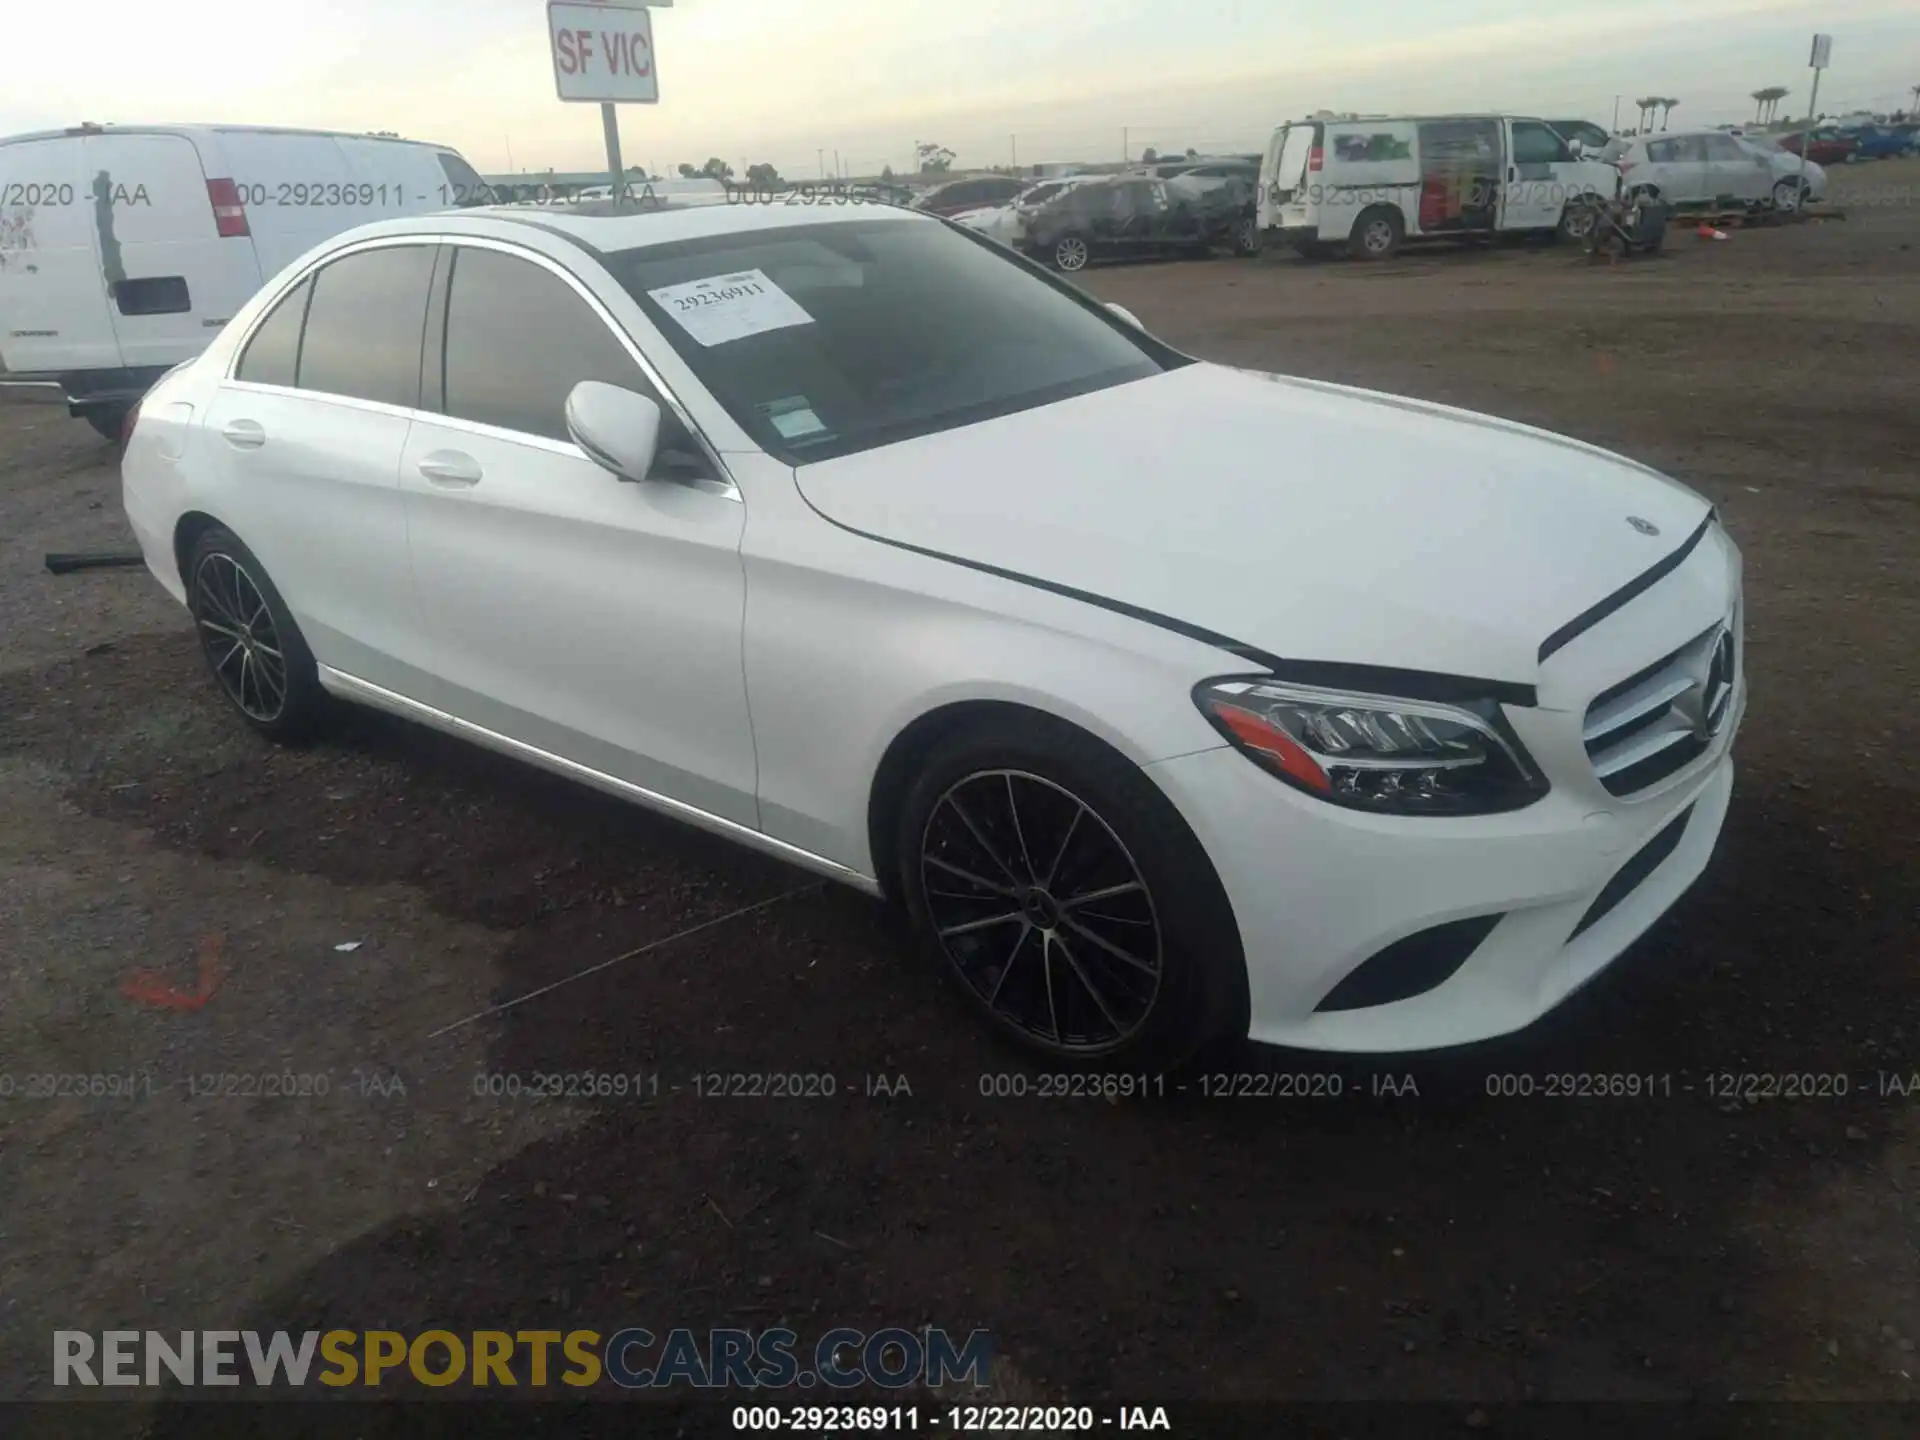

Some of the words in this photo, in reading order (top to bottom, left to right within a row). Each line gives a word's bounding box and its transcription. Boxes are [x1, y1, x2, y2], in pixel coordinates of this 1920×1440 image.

[557, 28, 593, 75] SF
[600, 31, 651, 77] VIC
[673, 283, 766, 311] 29236911
